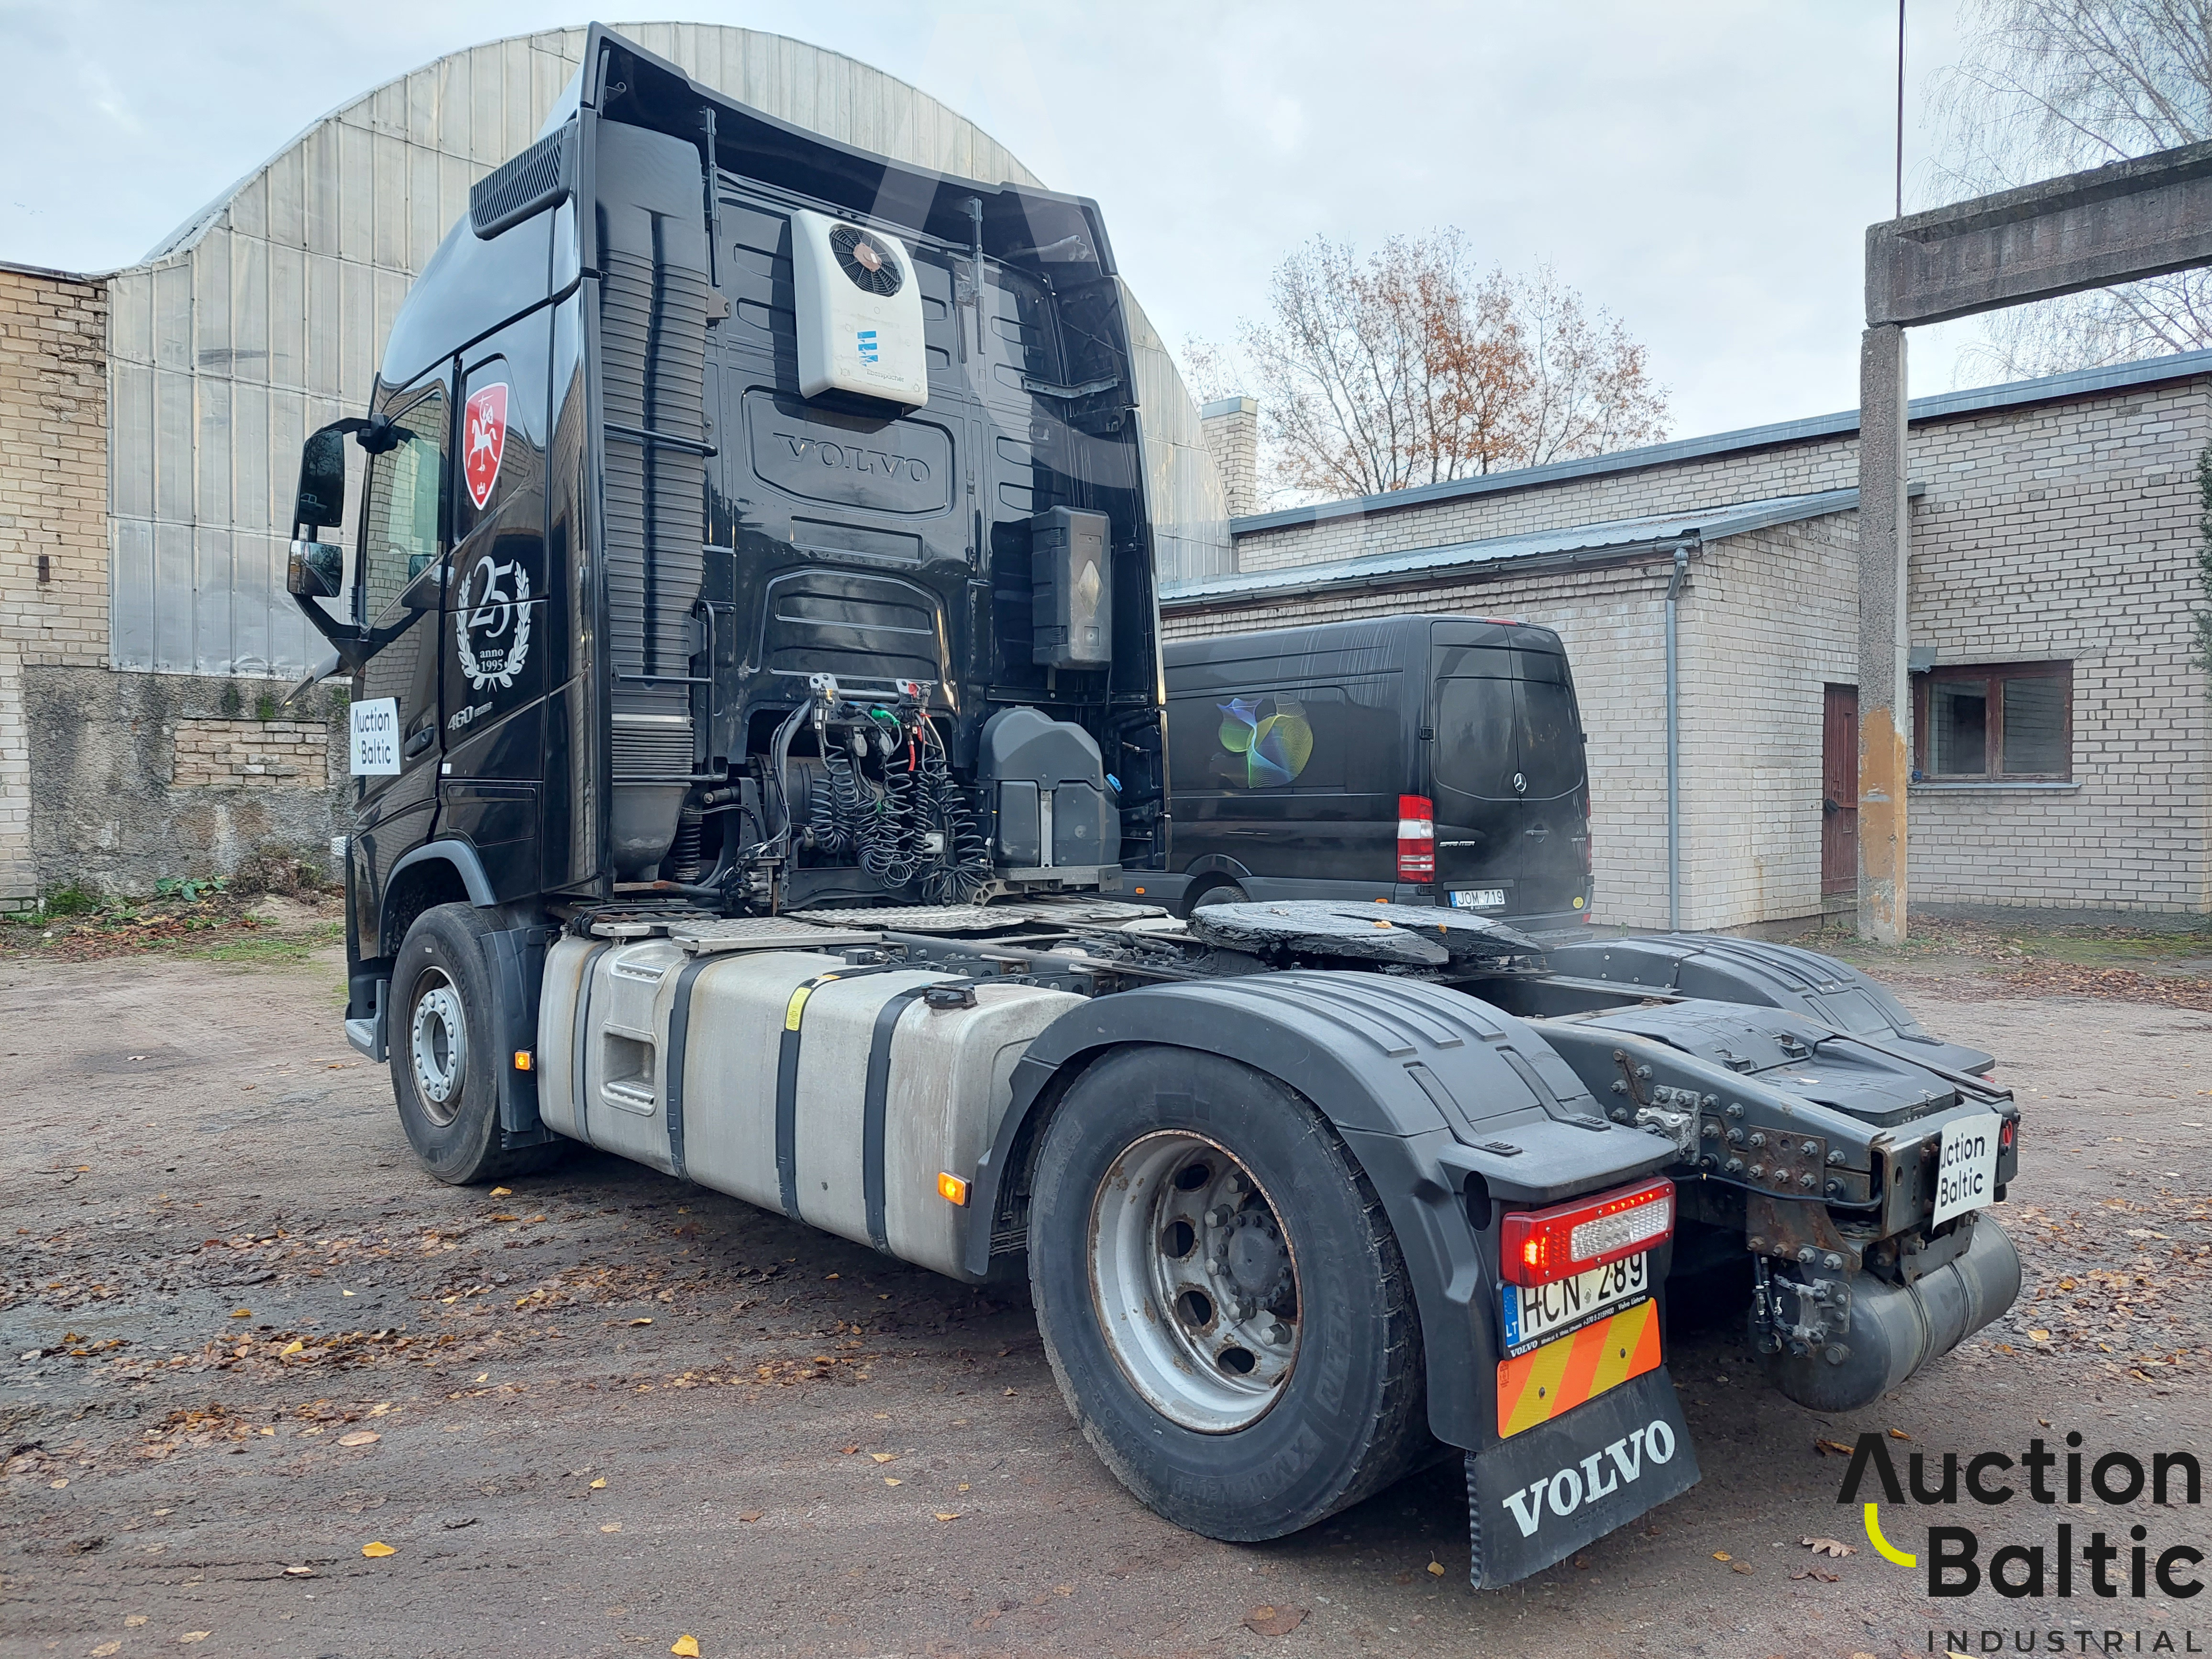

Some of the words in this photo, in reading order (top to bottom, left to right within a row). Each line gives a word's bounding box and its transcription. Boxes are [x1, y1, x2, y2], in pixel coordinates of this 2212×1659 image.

[773, 432, 930, 485] VOLVO
[467, 555, 514, 638] 25
[479, 648, 504, 658] anno
[481, 659, 503, 672] 1995
[354, 706, 390, 734] Auction
[447, 706, 474, 731] 460
[361, 738, 391, 764] Baltic
[1458, 891, 1480, 905] JOM
[1484, 890, 1503, 904] 719
[1940, 1167, 1983, 1207] Baltic
[1506, 1321, 1518, 1338] LT
[1522, 1274, 1581, 1334] HCN
[1598, 1253, 1643, 1302] 289
[1510, 1339, 1538, 1358] VOLVO
[1618, 1301, 1630, 1310] Volvo
[1631, 1295, 1646, 1305] Lietuva
[1502, 1420, 1675, 1538] VOLVO
